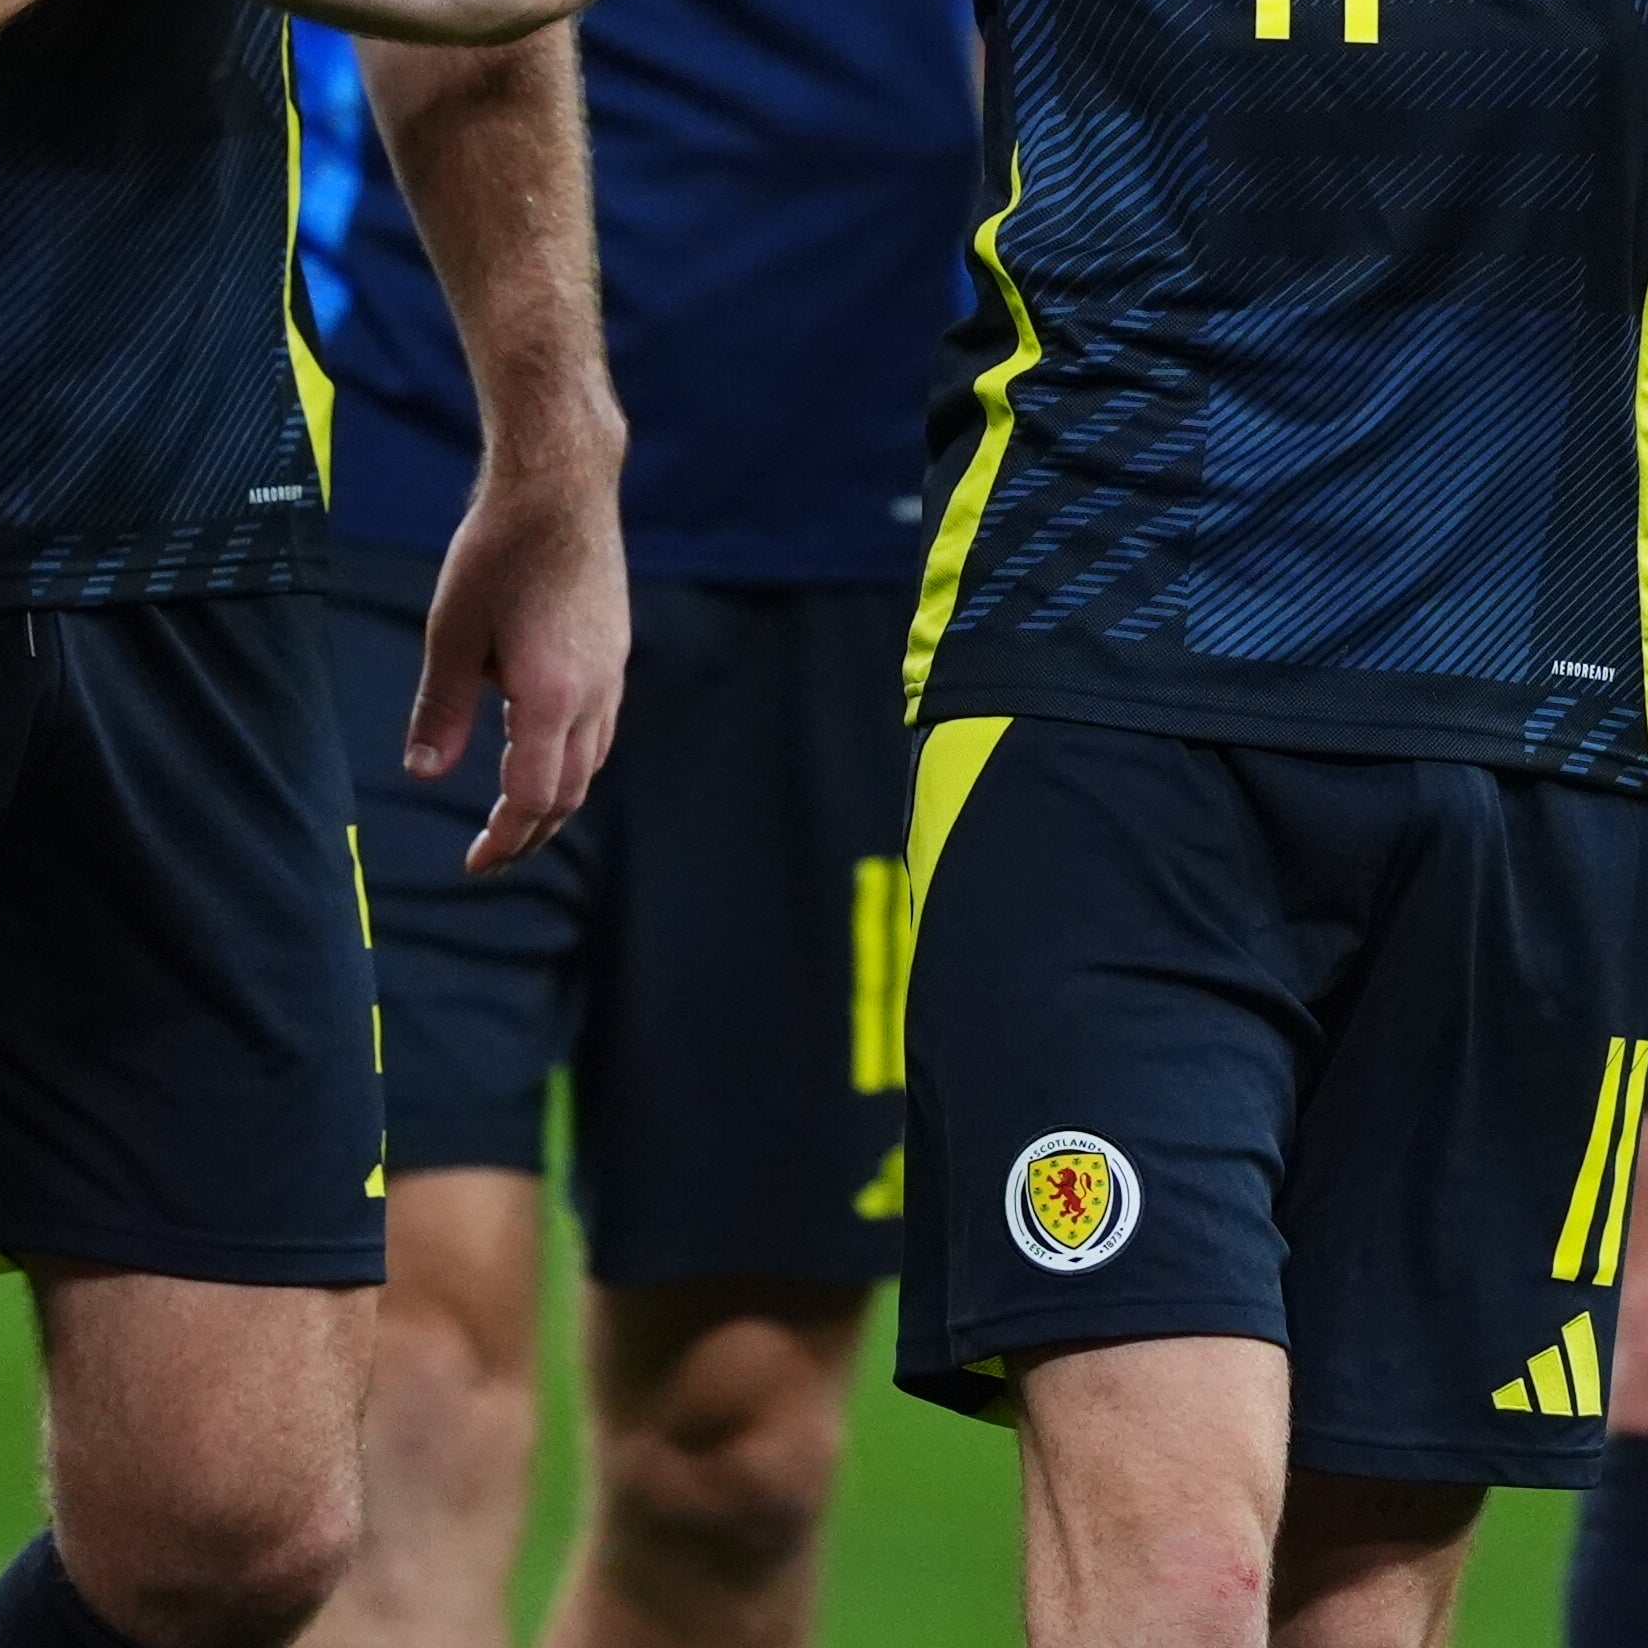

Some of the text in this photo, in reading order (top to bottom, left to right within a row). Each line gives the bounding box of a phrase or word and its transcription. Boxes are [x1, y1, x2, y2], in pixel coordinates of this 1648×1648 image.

[1551, 660, 1616, 682] AEROREADY
[1033, 1139, 1096, 1158] SCOTLAND
[1028, 1242, 1047, 1259] EST
[1103, 1231, 1122, 1251] 1873
